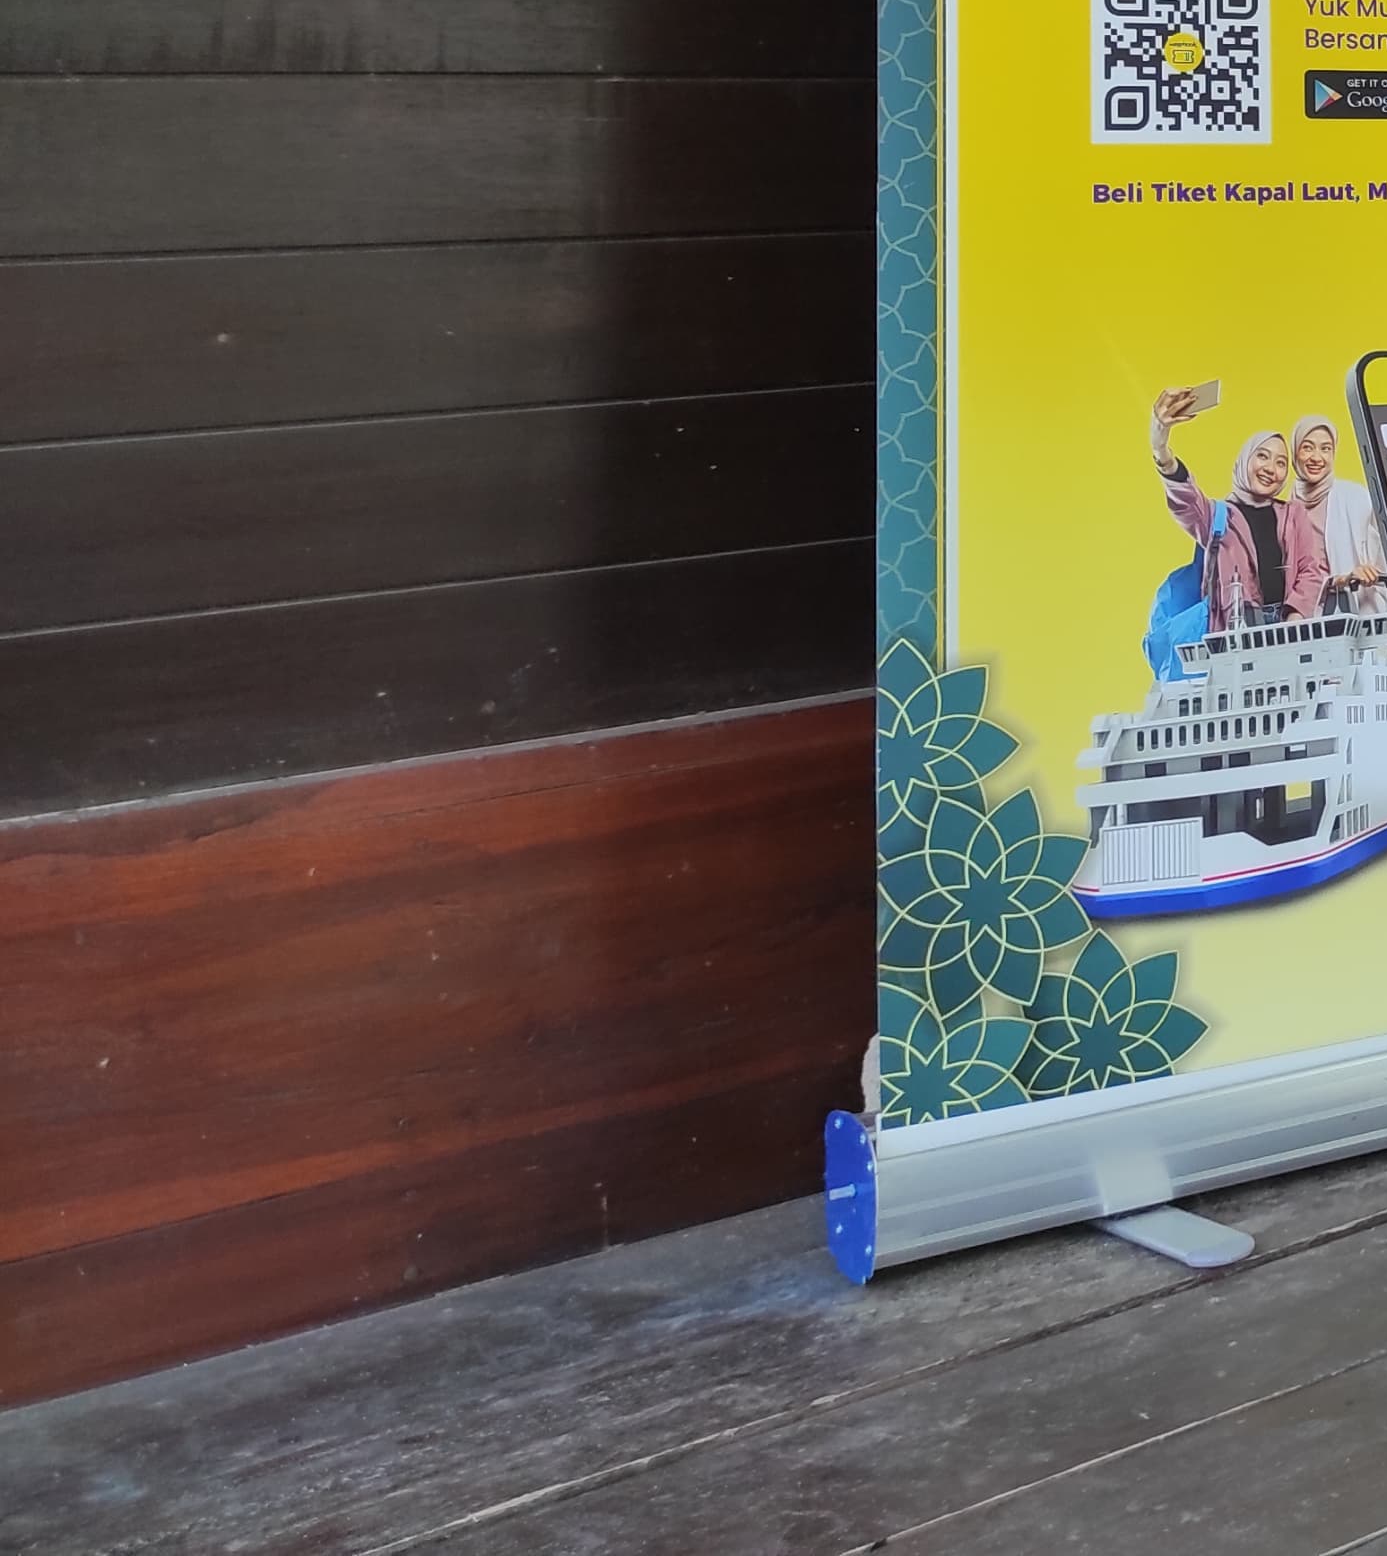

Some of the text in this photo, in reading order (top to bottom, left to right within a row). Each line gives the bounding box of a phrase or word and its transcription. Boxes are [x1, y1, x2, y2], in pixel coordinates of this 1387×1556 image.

[1346, 78, 1369, 88] GET
[1370, 78, 1379, 88] IT
[1091, 182, 1143, 204] Beli
[1151, 181, 1217, 204] Tiket
[1224, 181, 1295, 209] Kapal
[1302, 181, 1361, 205] Laut,
